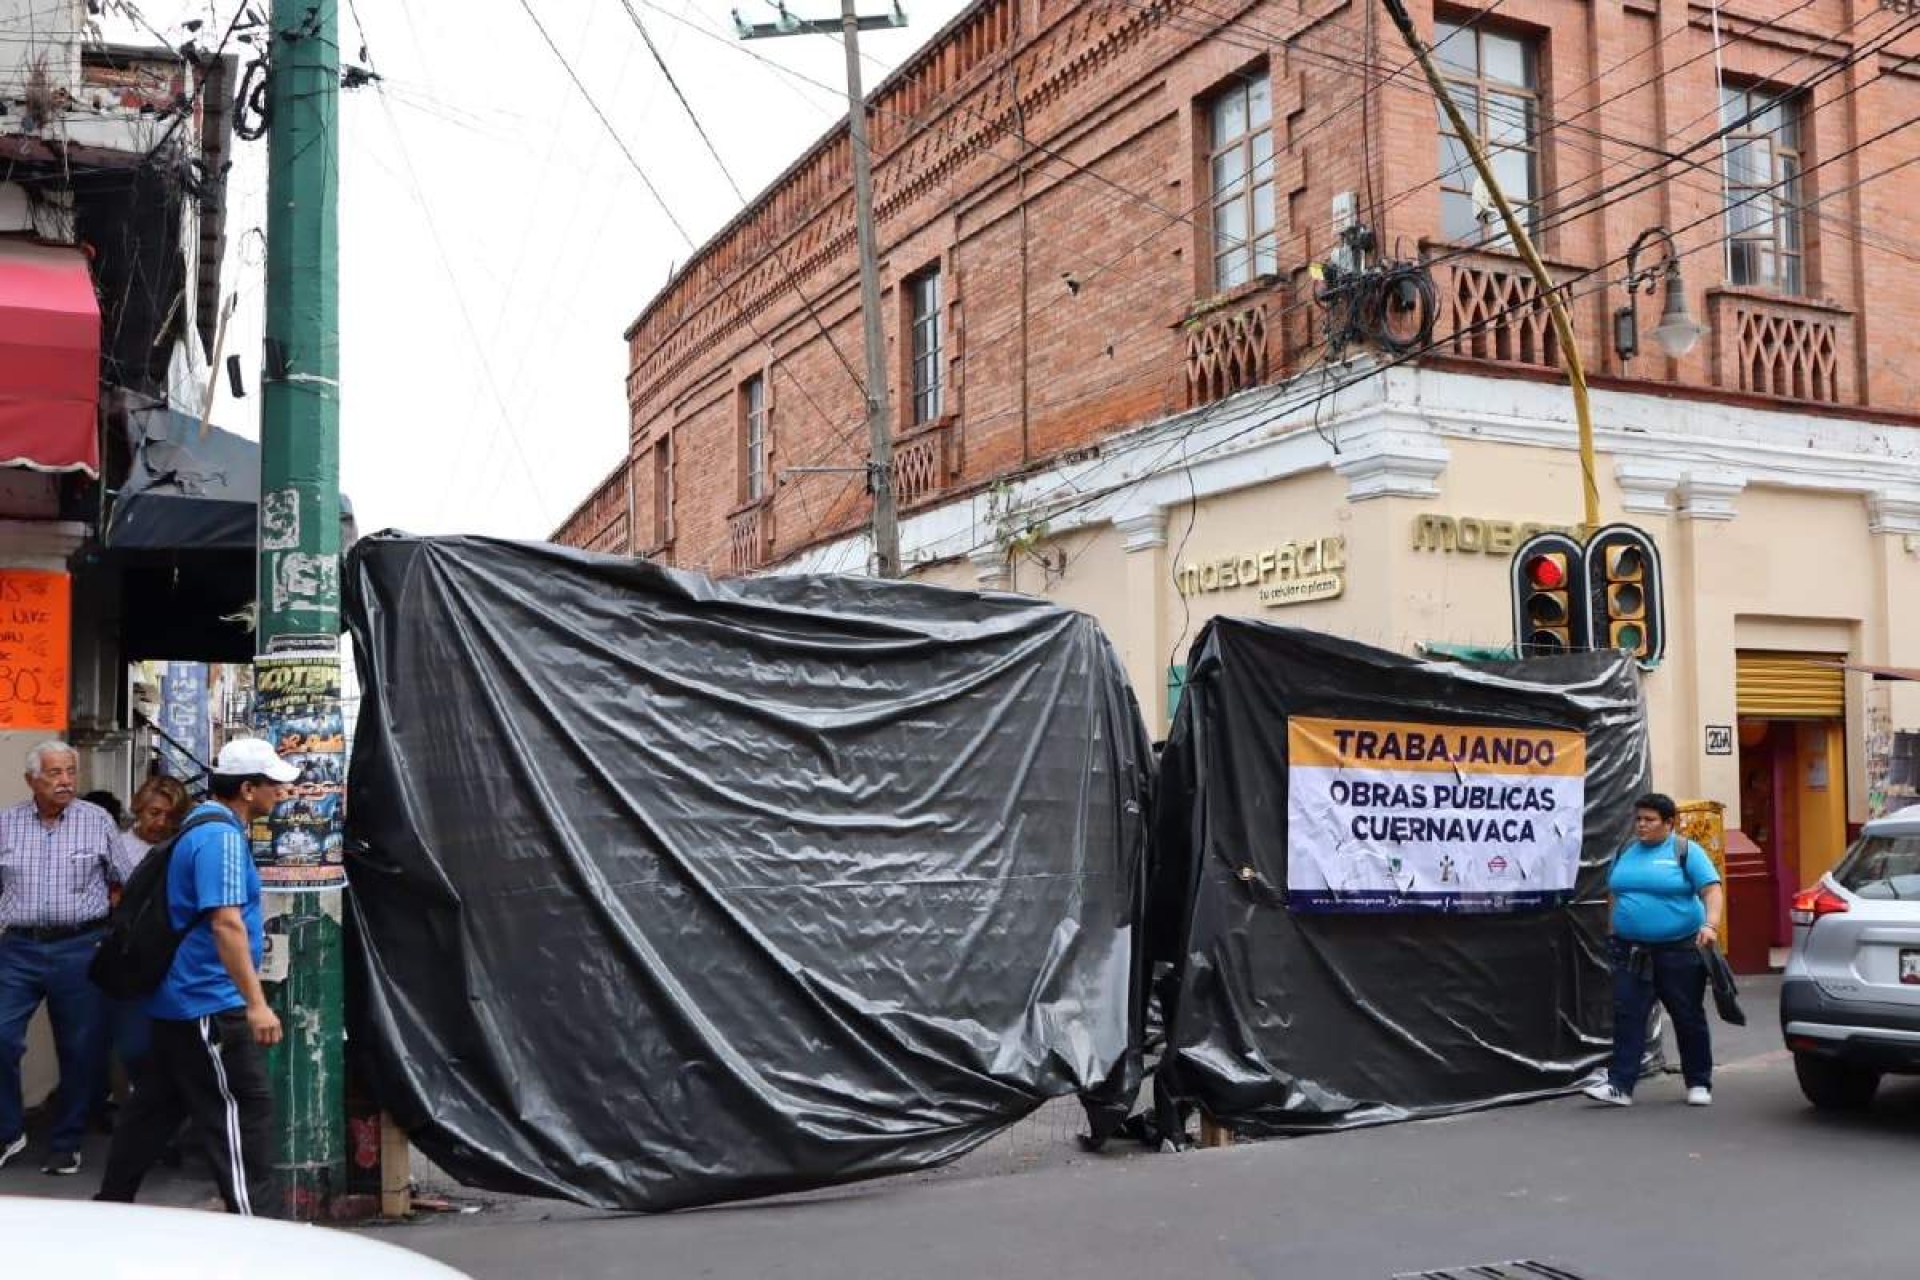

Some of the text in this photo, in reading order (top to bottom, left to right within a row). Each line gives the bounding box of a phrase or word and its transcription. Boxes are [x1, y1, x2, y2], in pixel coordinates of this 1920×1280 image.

[1333, 729, 1555, 767] TRABAJANDO
[1330, 780, 1427, 808] OBRAS
[1352, 815, 1535, 843] CUERNAVACA
